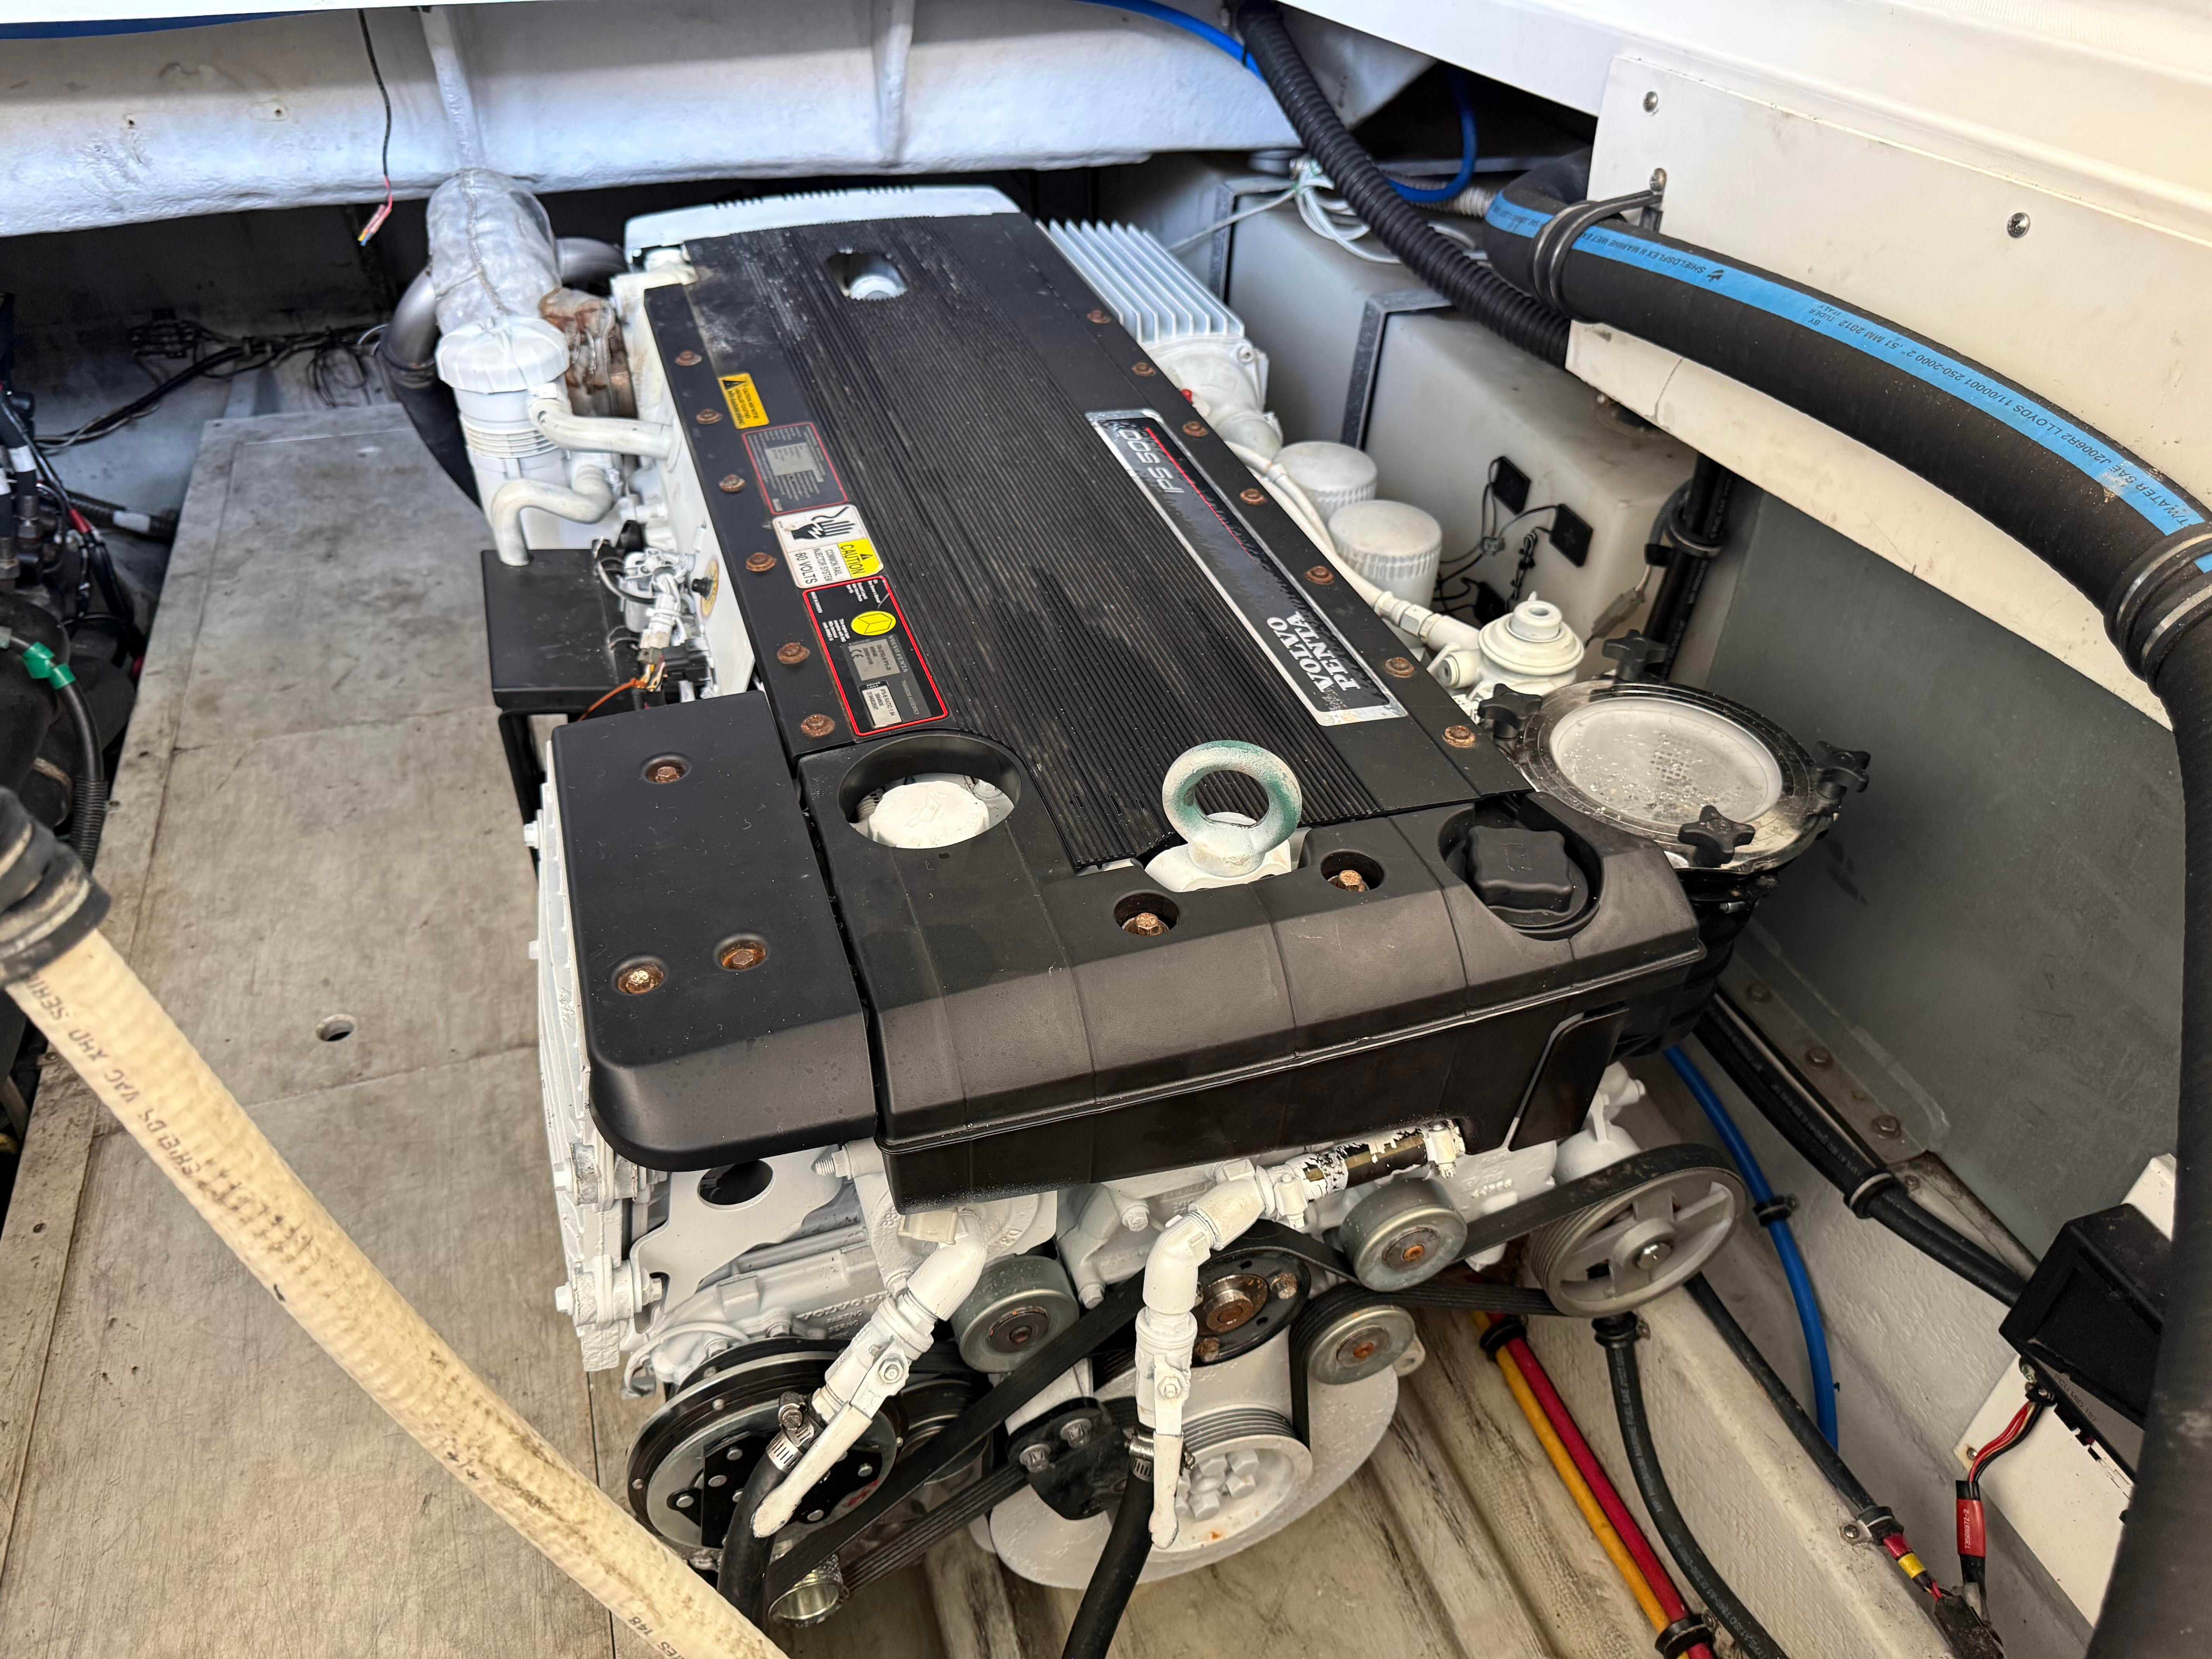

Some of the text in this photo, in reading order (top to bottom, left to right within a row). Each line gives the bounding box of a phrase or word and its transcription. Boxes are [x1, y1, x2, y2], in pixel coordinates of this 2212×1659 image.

[1808, 316, 1821, 327] BY
[1838, 318, 1865, 335] 2012
[1863, 328, 1884, 343] MM
[1914, 351, 1965, 382] 250-2000
[1963, 377, 2013, 407] 11/00001
[2013, 403, 2063, 436] LLOYDS
[1116, 428, 1162, 464] 500
[2060, 431, 2111, 467] J2006R2
[2109, 462, 2138, 485] SAE
[794, 552, 818, 584] 80 VOLTS
[811, 548, 834, 582] INJECTOR SYSTEM
[824, 549, 843, 576] COMMON RAIL
[839, 543, 866, 575] CAUTION
[887, 635, 909, 673] VOLVO PENTA
[1263, 615, 1339, 690] VOLVO
[1281, 611, 1362, 691] PENTA
[883, 697, 893, 709] RATIO
[900, 680, 920, 715] TRANSOM ASSEMBLY
[105, 1068, 141, 1104] VAC
[2068, 1391, 2086, 1408] MID
[628, 1613, 654, 1639] 148
